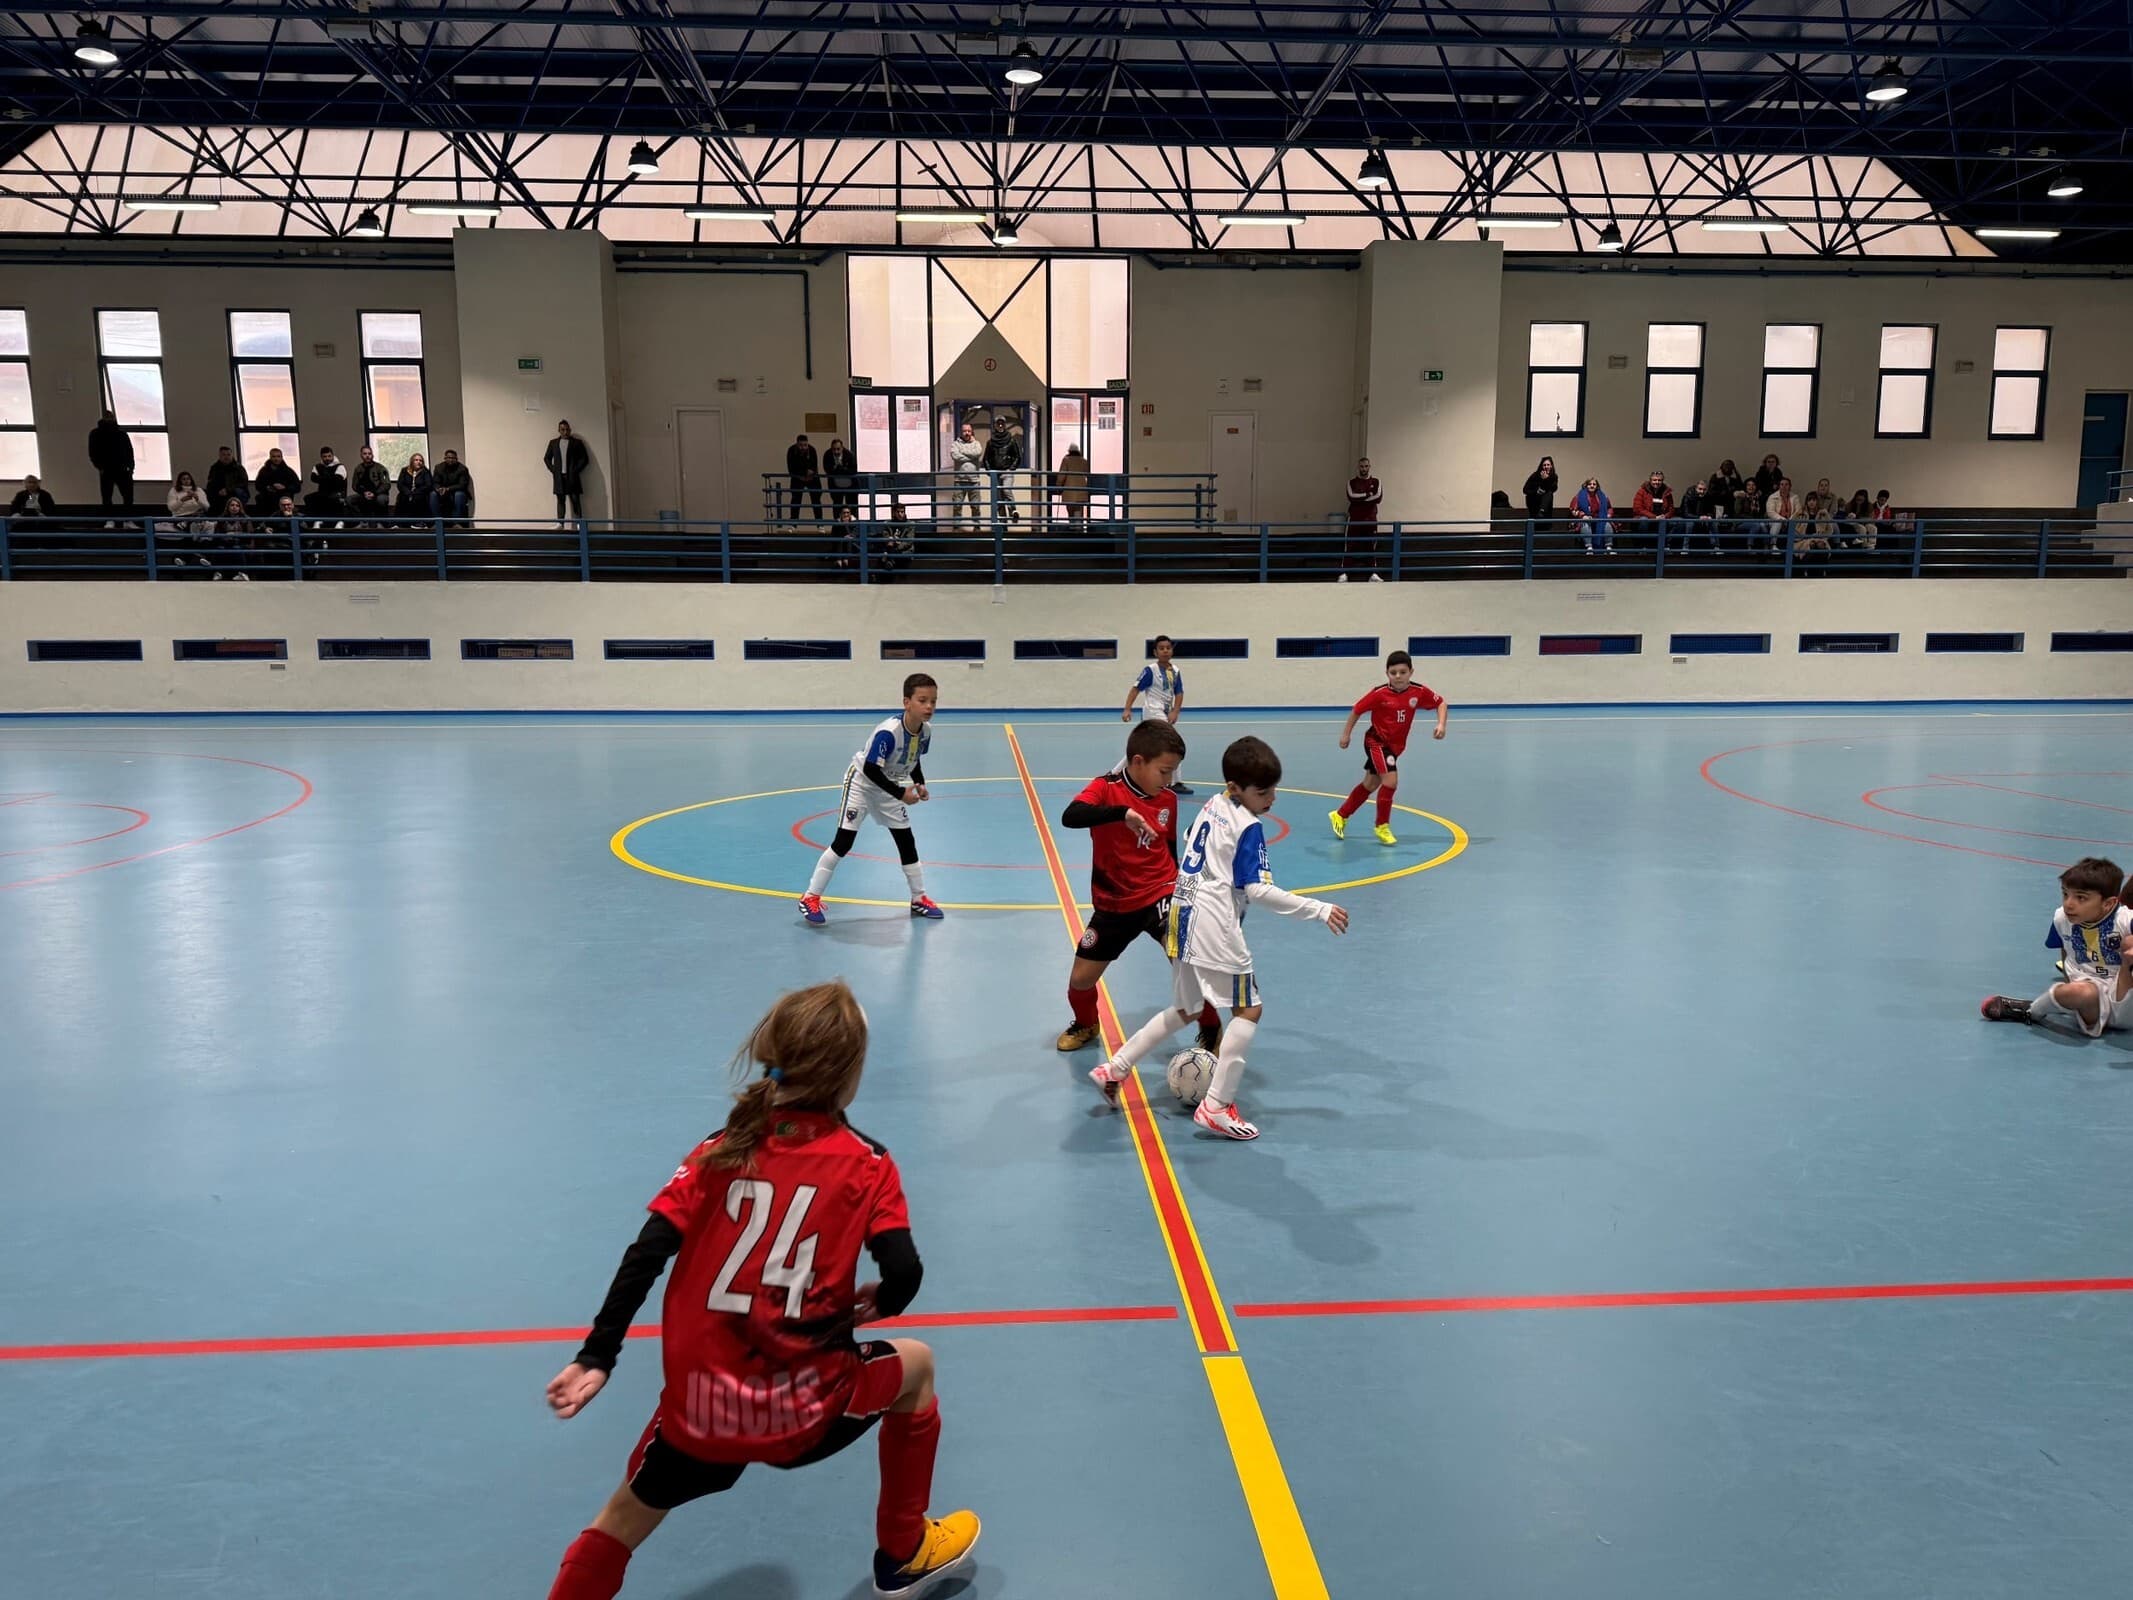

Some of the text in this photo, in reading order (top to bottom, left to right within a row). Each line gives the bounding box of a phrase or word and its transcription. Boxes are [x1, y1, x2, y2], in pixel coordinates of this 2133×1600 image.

[1396, 709, 1406, 723] 15
[1182, 821, 1211, 875] 9
[2091, 950, 2099, 961] 6
[706, 1178, 820, 1319] 24
